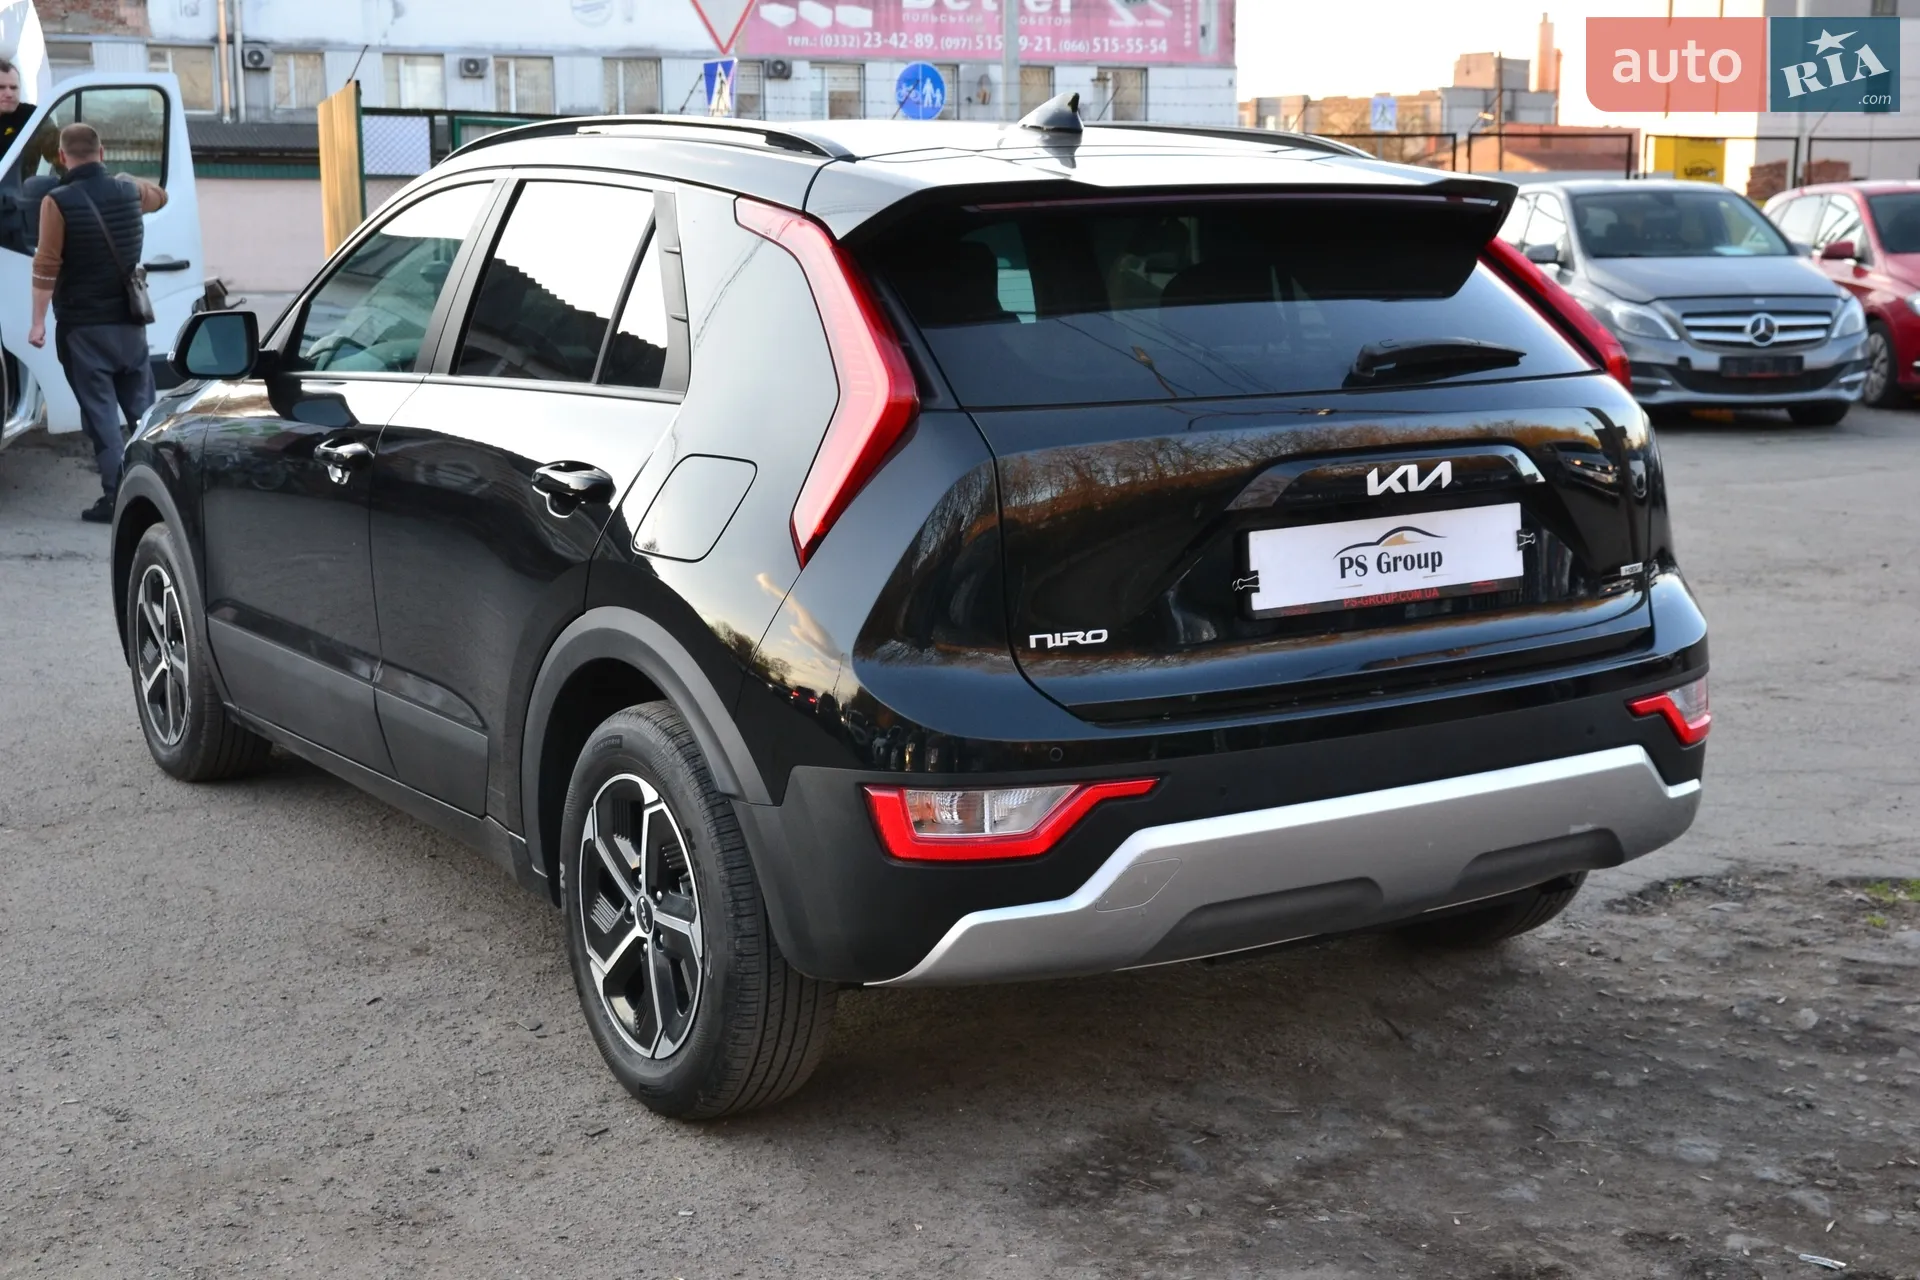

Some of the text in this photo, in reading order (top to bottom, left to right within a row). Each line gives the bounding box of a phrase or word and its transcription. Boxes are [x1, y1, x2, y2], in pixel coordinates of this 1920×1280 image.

[820, 33, 861, 49] (0332)
[940, 35, 972, 52] (097)
[1059, 38, 1090, 55] (066)
[1092, 36, 1168, 54] 515-55-54
[1366, 460, 1452, 496] KIA
[1340, 550, 1443, 579] PS Group
[1029, 629, 1108, 649] NIRO
